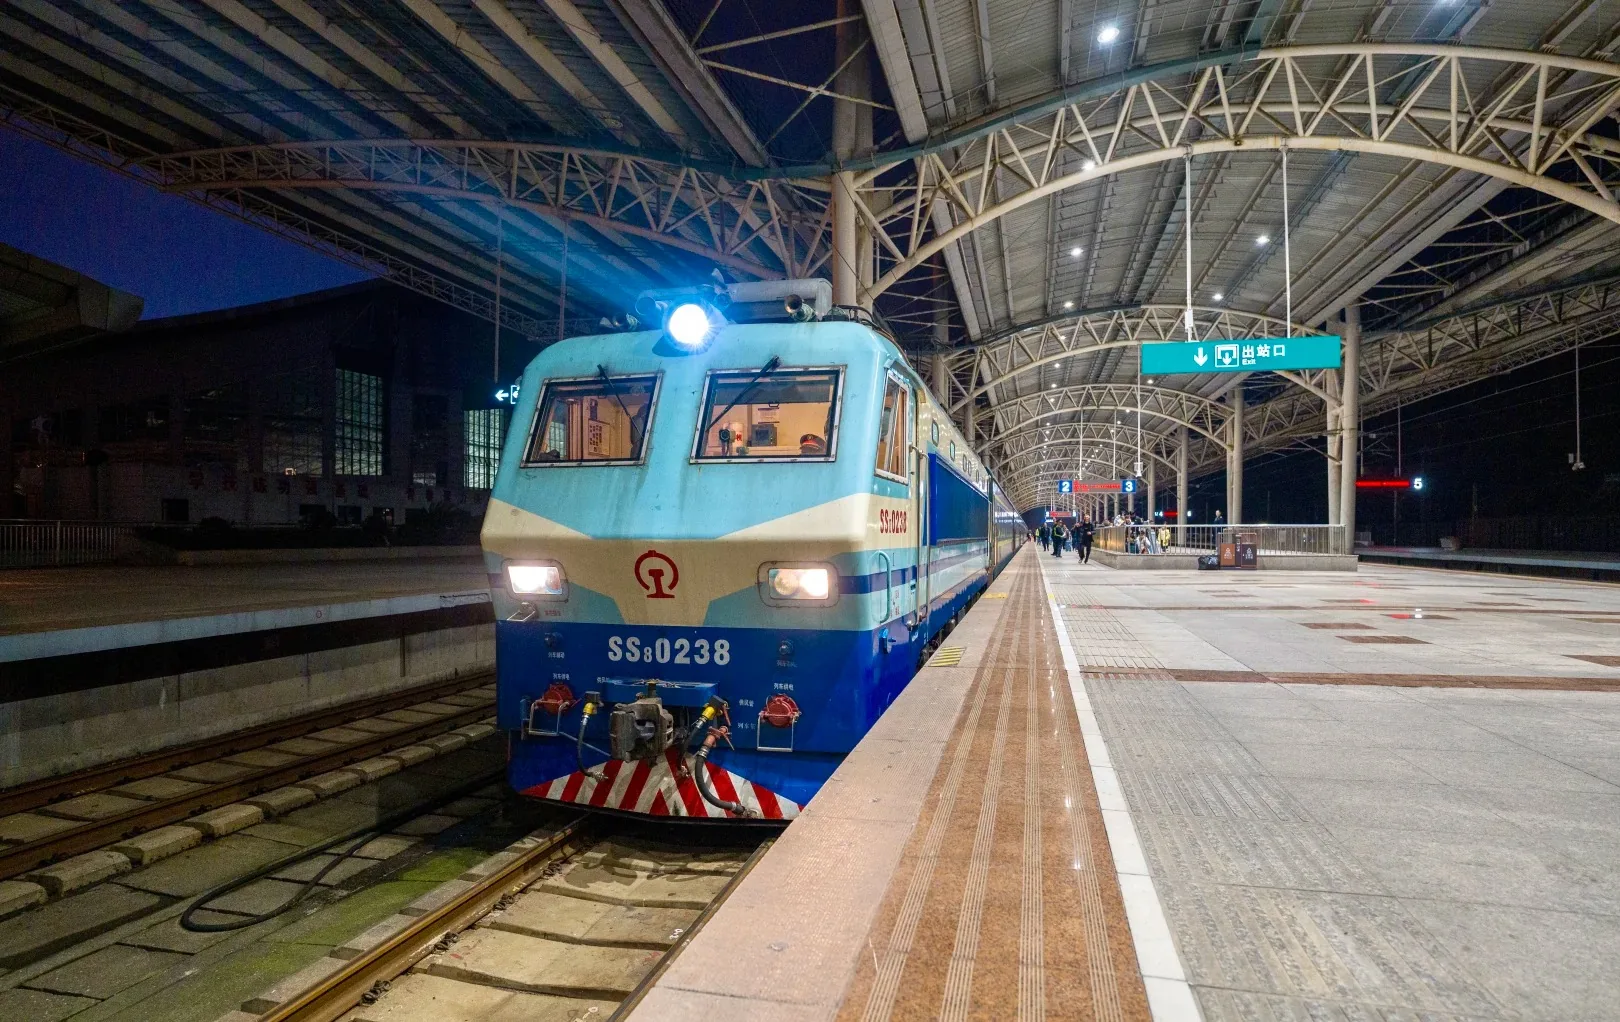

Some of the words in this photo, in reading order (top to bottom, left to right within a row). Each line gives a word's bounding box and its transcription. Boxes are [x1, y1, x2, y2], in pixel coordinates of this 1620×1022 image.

[1242, 344, 1286, 359] 出站口
[1242, 358, 1257, 366] Exit
[1062, 481, 1070, 492] 2
[1125, 481, 1133, 492] 3
[1413, 477, 1423, 490] 5
[608, 635, 731, 666] SS80238
